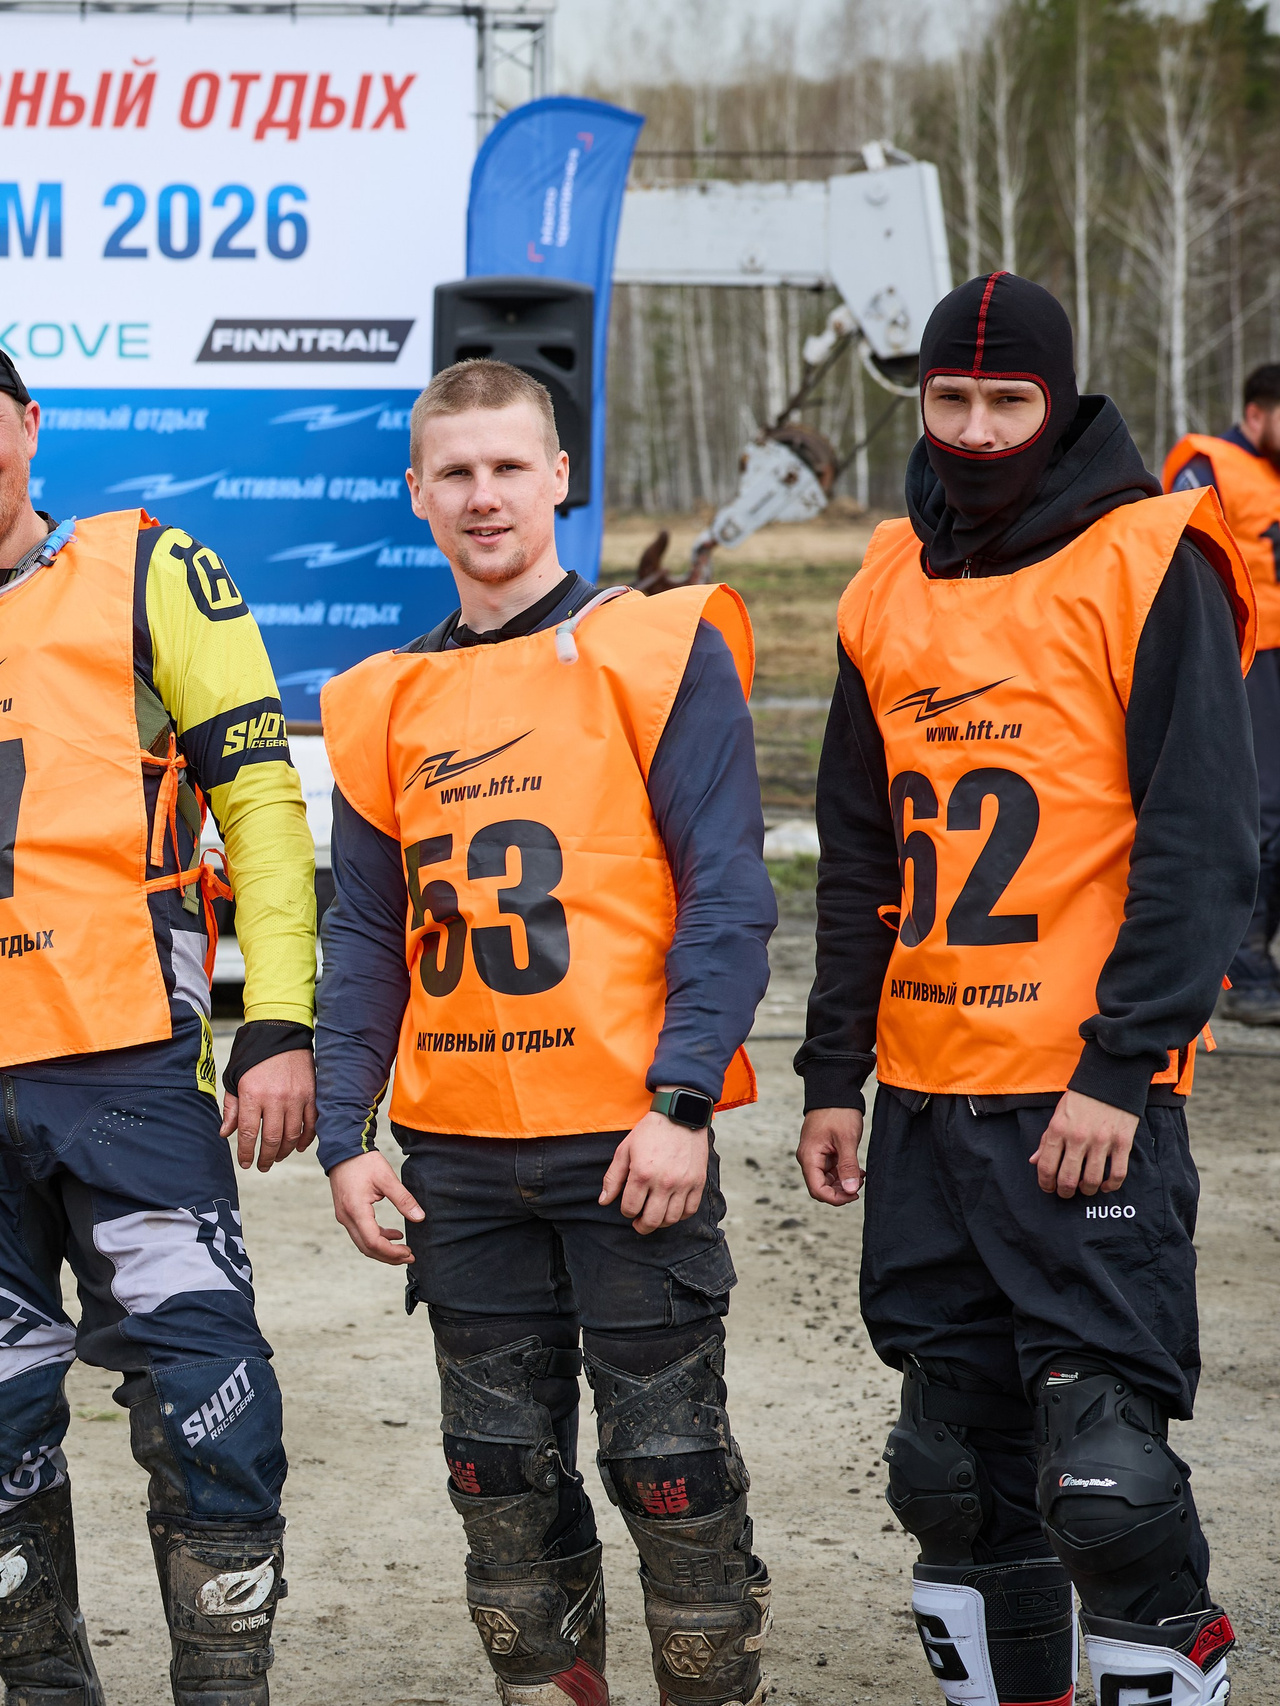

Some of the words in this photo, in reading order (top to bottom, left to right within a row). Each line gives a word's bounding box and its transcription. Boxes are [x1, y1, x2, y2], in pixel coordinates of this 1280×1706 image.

[178, 71, 417, 142] ОТДЫХ
[101, 182, 310, 261] 2026
[210, 327, 400, 353] FINNTRAIL
[925, 719, 1023, 743] www.hft.ru
[440, 774, 543, 805] www.hft.ru
[889, 767, 1041, 949] 62
[403, 818, 571, 998] 53
[890, 978, 958, 1006] АКТИВНЫЙ
[962, 981, 1043, 1009] ОТДЫХ
[501, 1026, 577, 1054] ОТДЫХ
[1086, 1205, 1137, 1220] HUGO
[181, 1360, 251, 1449] SHOT
[210, 1411, 237, 1441] RACE
[234, 1388, 256, 1417] GEAR
